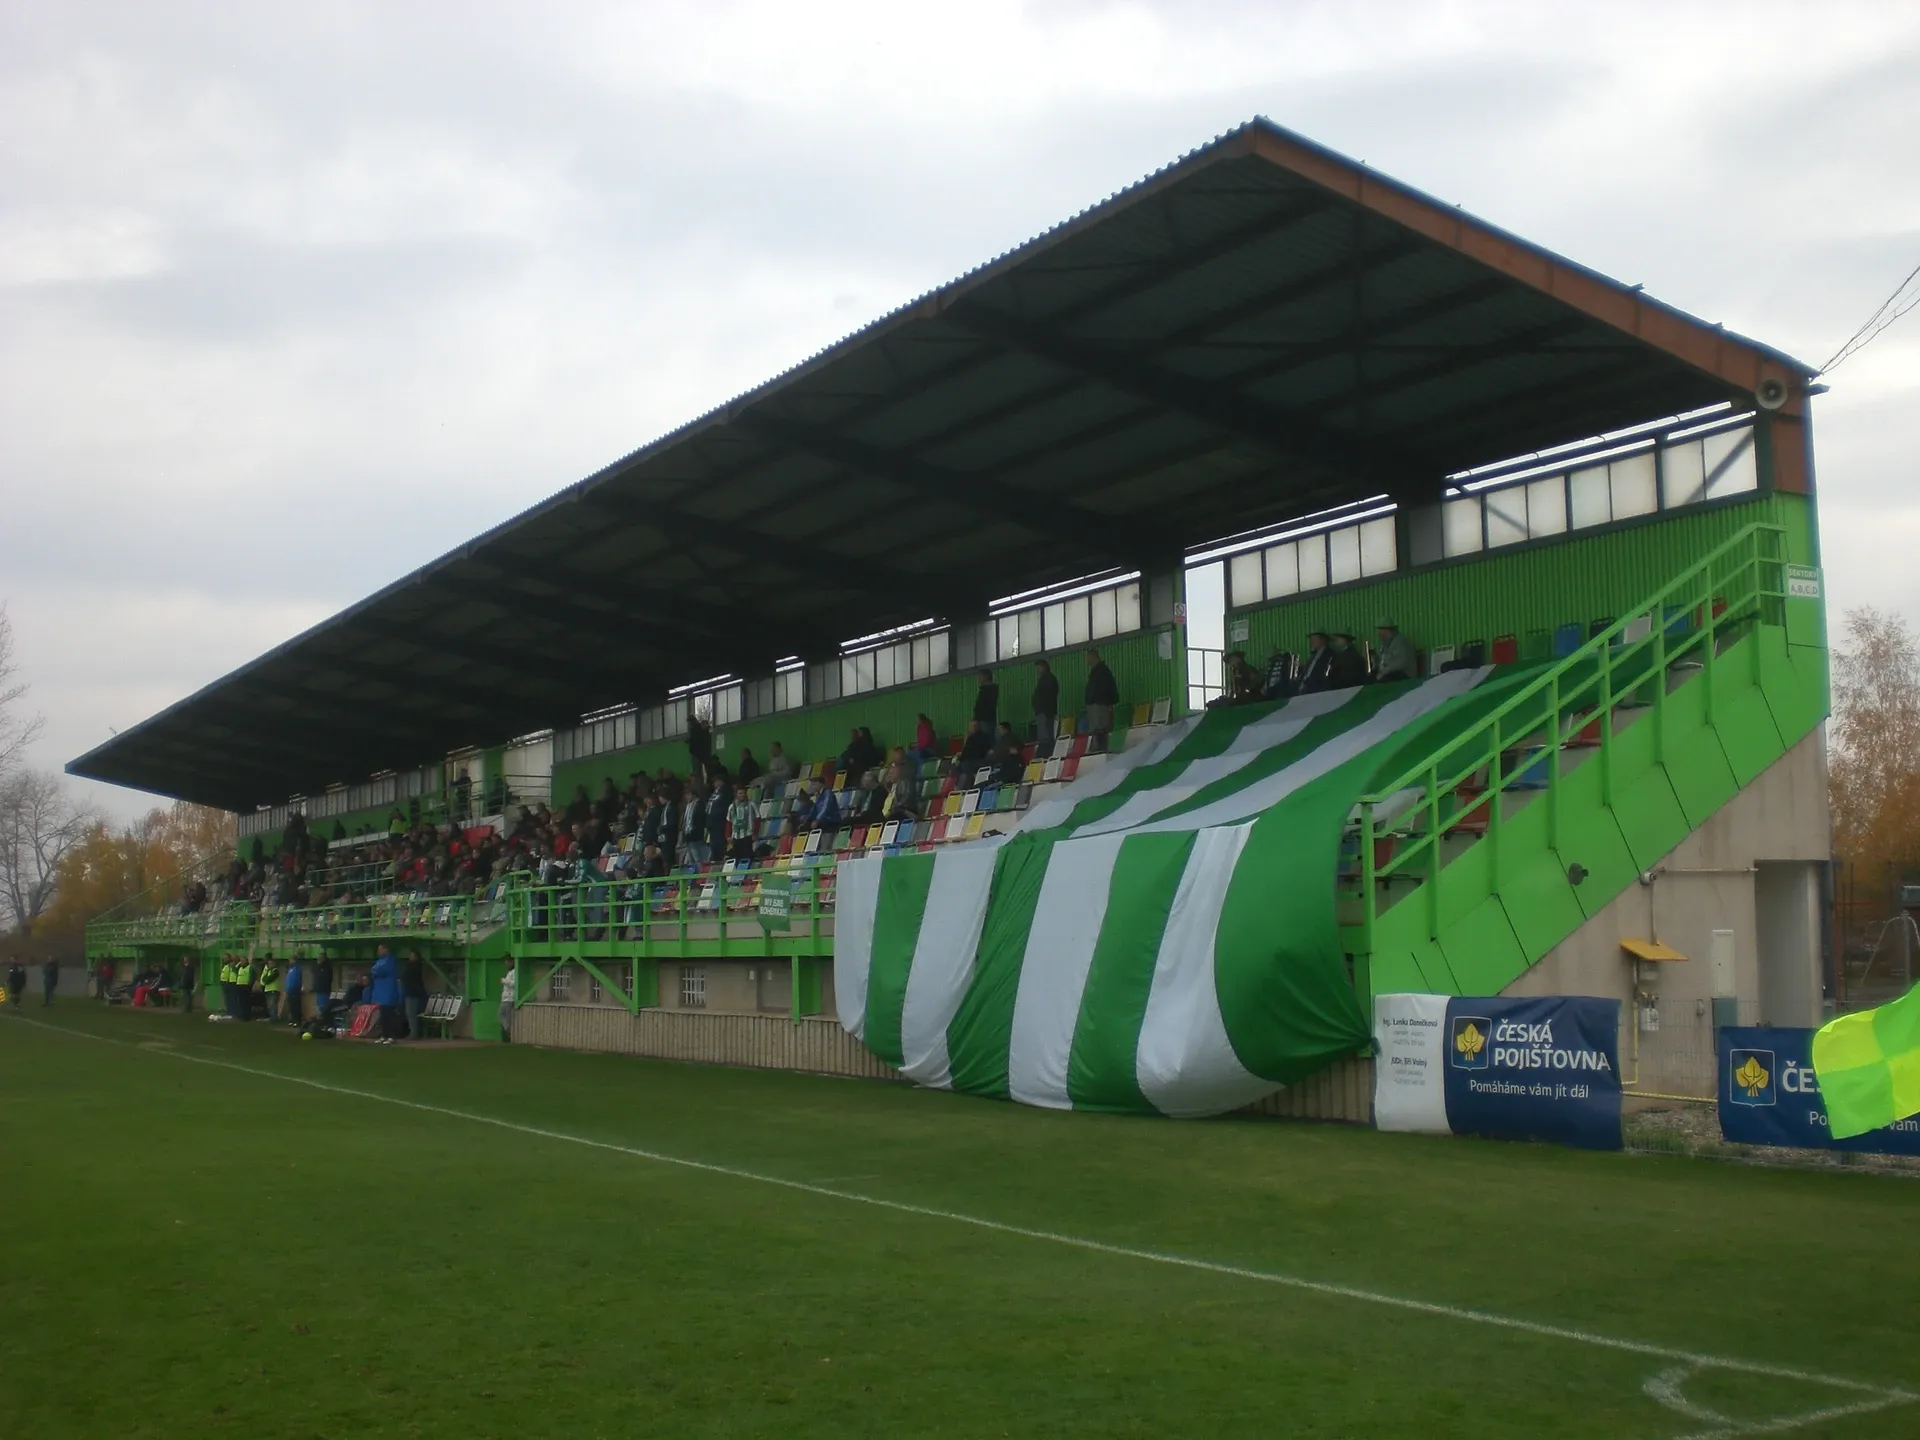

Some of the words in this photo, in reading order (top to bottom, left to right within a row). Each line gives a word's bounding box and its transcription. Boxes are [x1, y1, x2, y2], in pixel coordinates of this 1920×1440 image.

[1495, 1019, 1553, 1043] ČESKÁ
[1494, 1044, 1612, 1071] POJIŠŤOVNA
[1470, 1079, 1526, 1095] Pomáháme
[1530, 1081, 1552, 1097] vám
[1555, 1082, 1567, 1100] jít
[1570, 1083, 1589, 1098] dál
